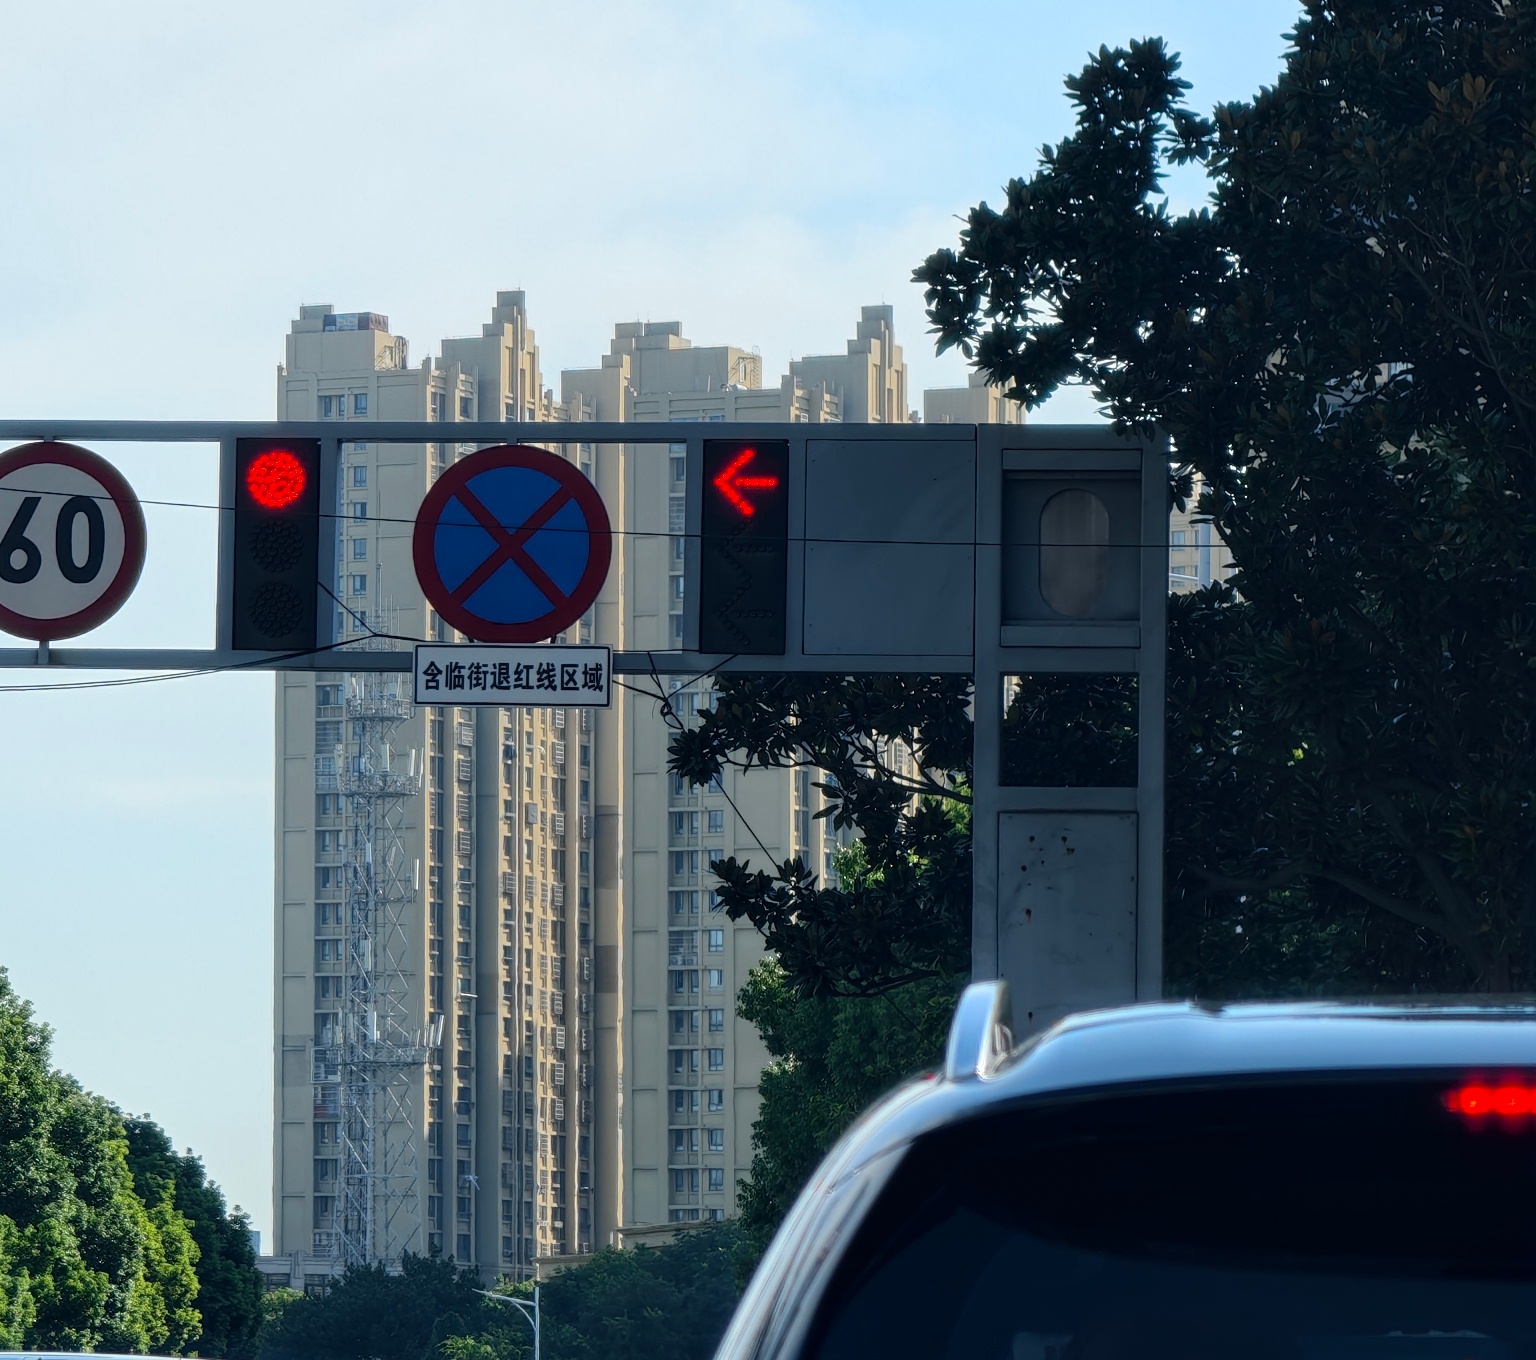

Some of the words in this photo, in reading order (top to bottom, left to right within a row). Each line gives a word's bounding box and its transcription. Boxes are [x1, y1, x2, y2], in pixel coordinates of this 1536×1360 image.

[422, 660, 604, 692] 含临街退红线区域
